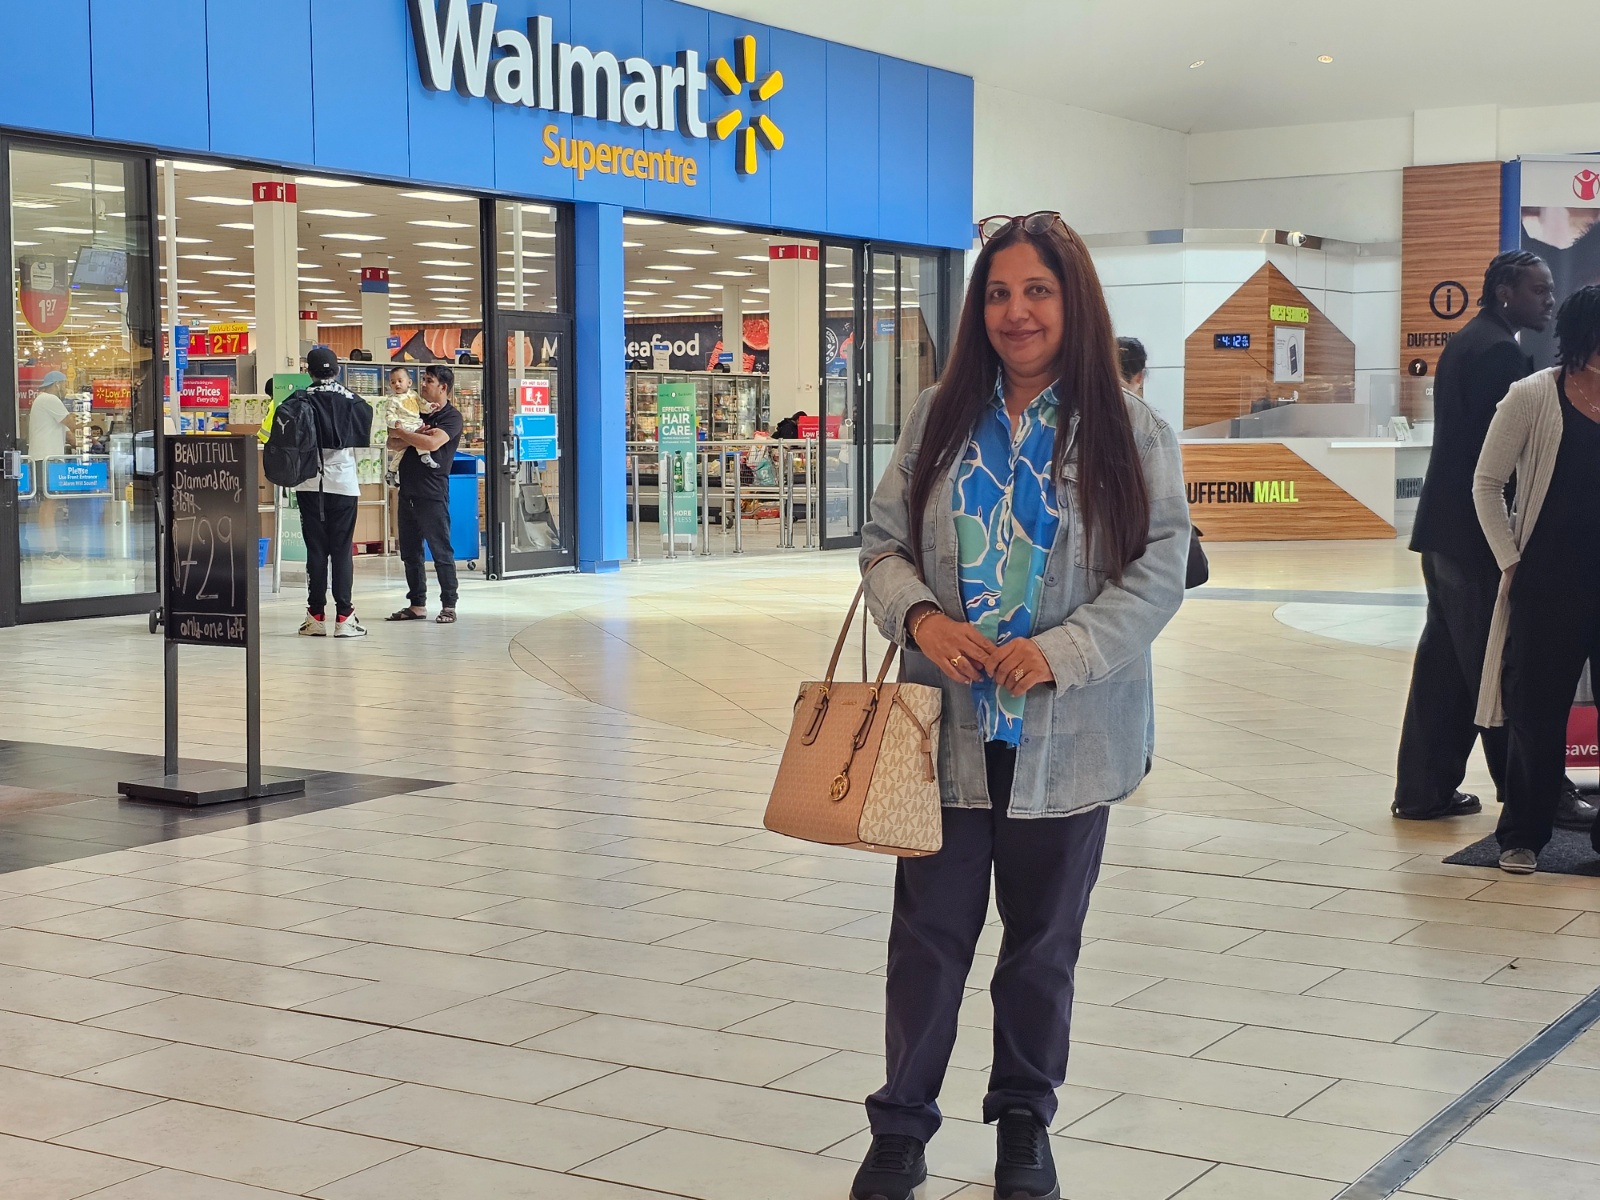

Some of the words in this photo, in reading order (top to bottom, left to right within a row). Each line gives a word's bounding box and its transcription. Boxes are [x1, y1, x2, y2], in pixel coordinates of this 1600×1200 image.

[411, 0, 707, 138] Walmart
[542, 124, 698, 187] Supercentre
[624, 332, 700, 358] eafood
[1407, 332, 1456, 347] DUFFER
[196, 386, 220, 396] Prices
[662, 414, 690, 424] HAIR
[662, 426, 692, 436] CARE.
[174, 442, 238, 465] BEAUTIFULL
[68, 466, 88, 475] Please
[176, 469, 218, 490] Diamond
[220, 470, 242, 503] Ring
[1185, 480, 1298, 504] UFFERINMALL
[180, 616, 203, 638] only
[204, 622, 224, 638] one
[226, 616, 244, 640] left
